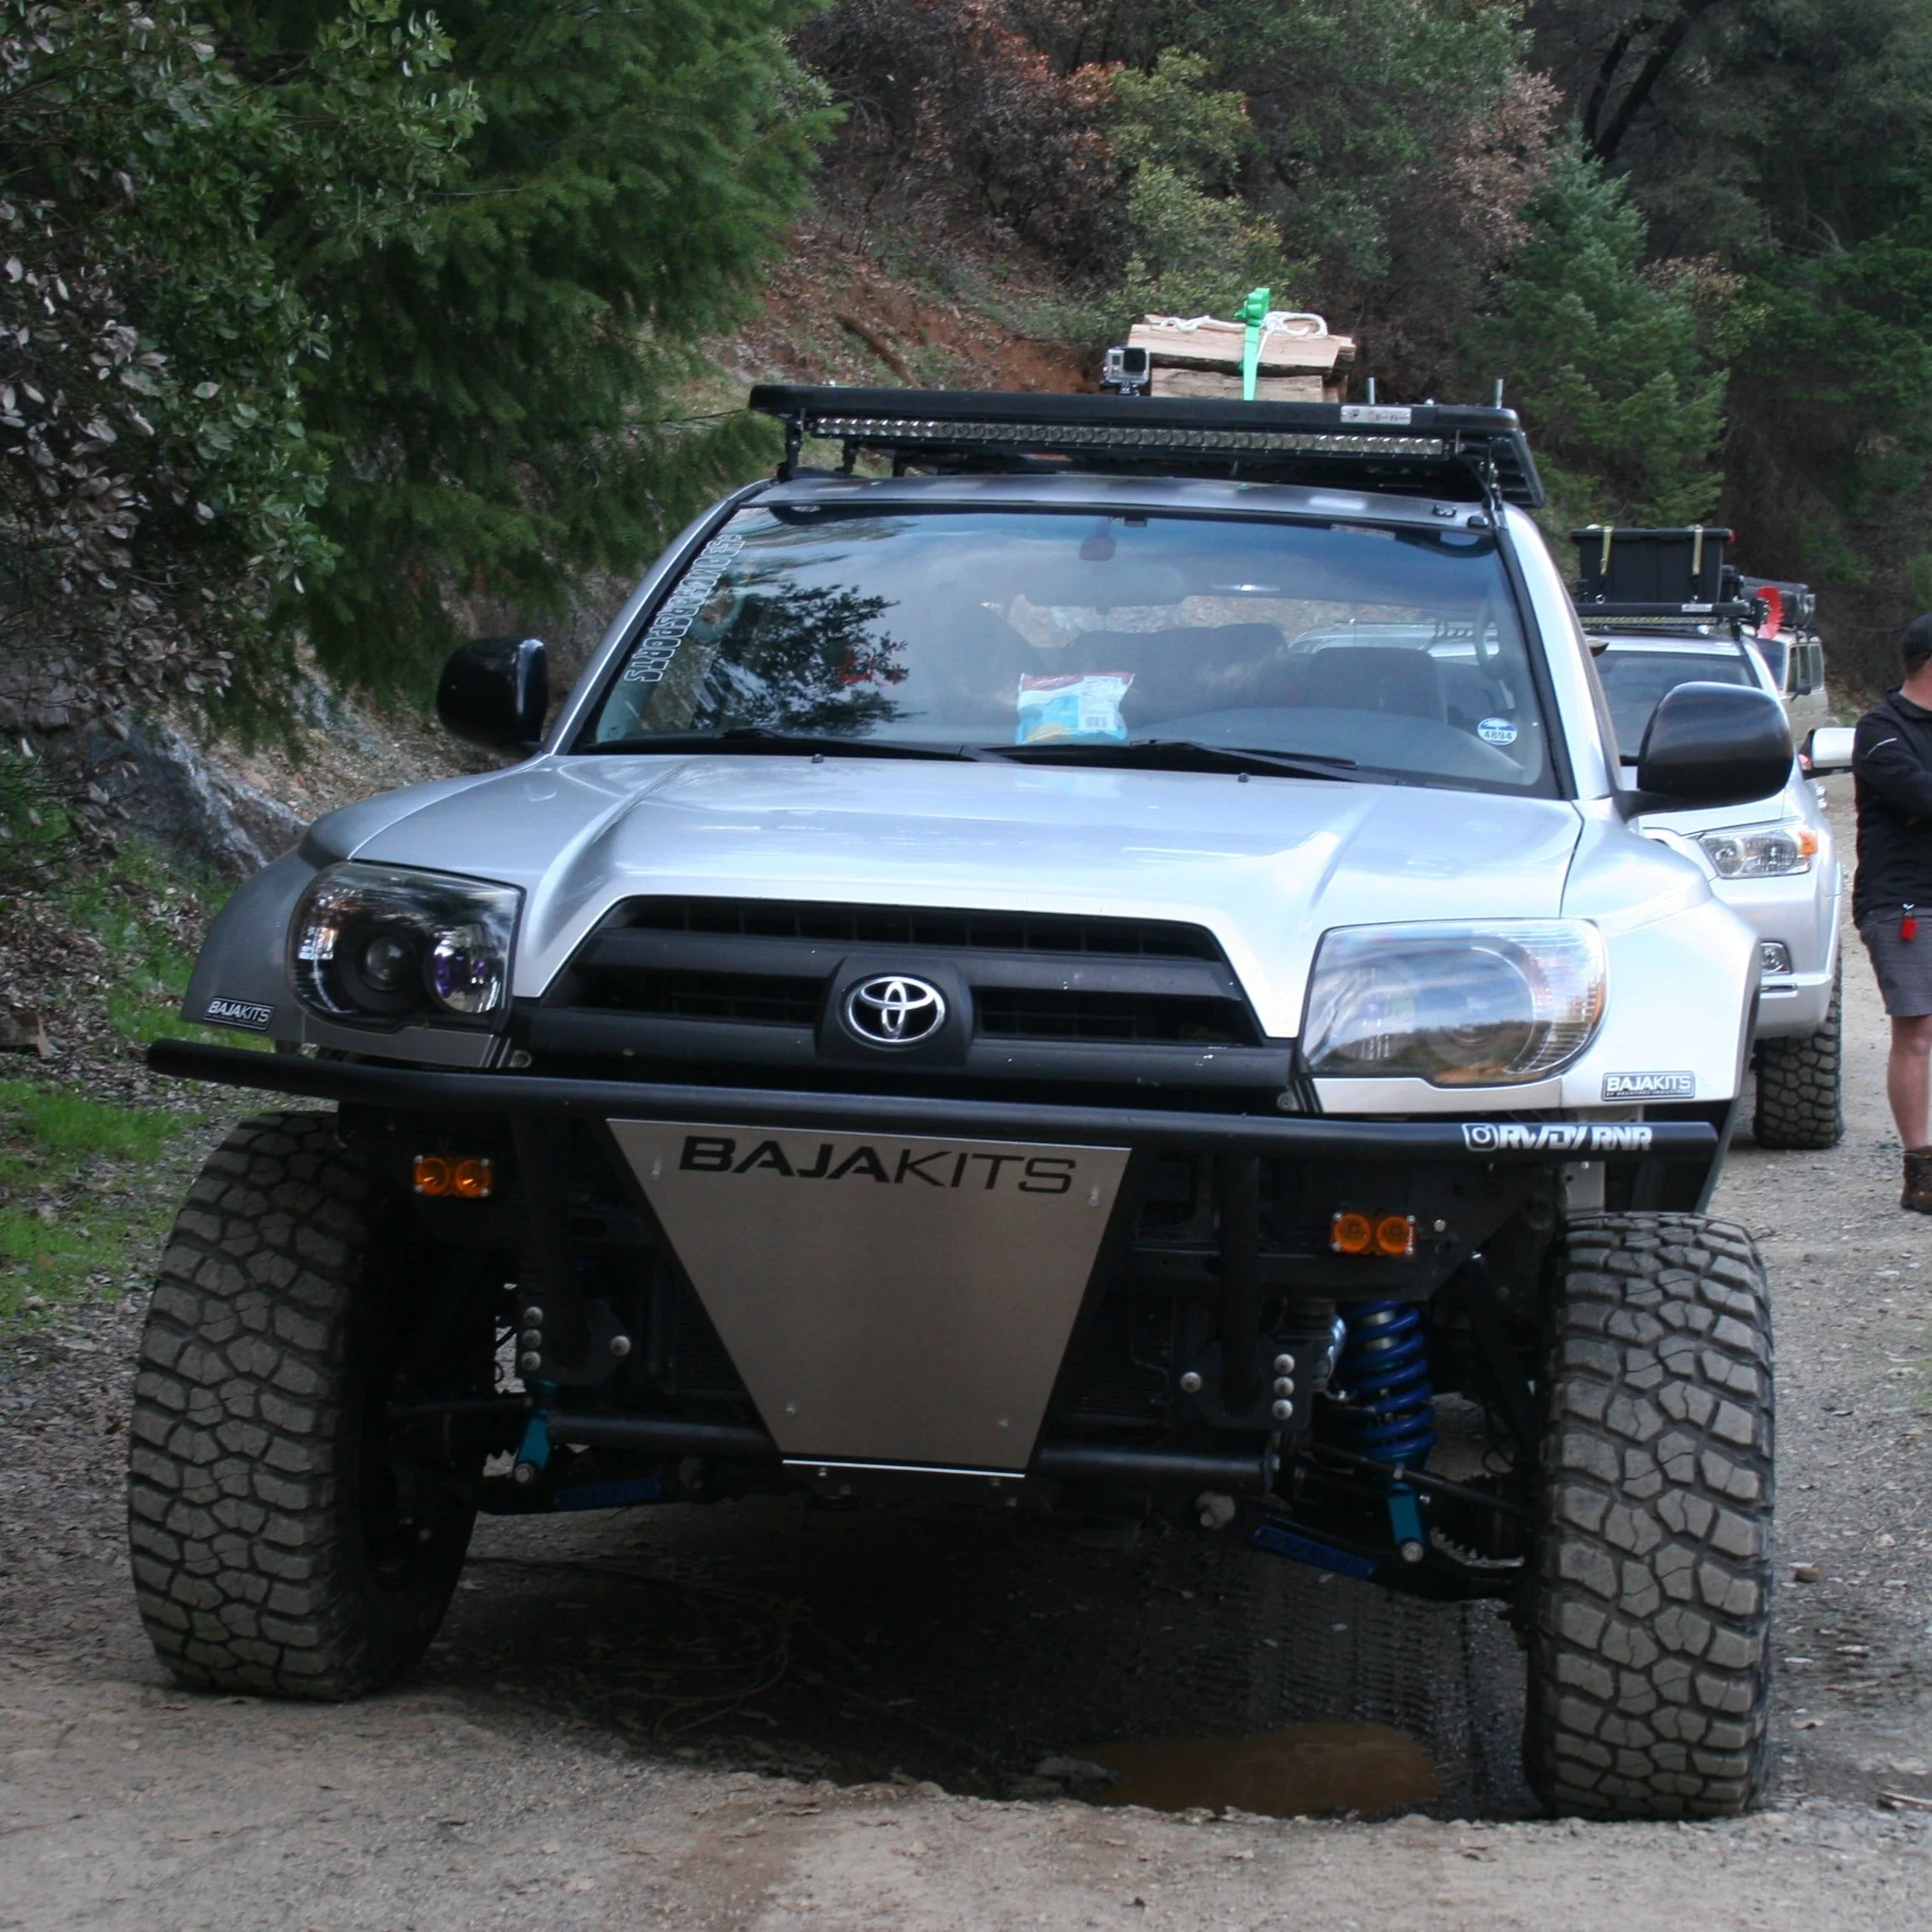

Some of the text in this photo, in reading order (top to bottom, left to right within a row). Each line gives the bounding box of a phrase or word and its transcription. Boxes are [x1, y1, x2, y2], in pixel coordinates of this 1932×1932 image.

[208, 1001, 271, 1022] BAJAKITS
[1606, 1075, 1691, 1091] BAJAKITS
[679, 1135, 1077, 1194] BAJAKITS
